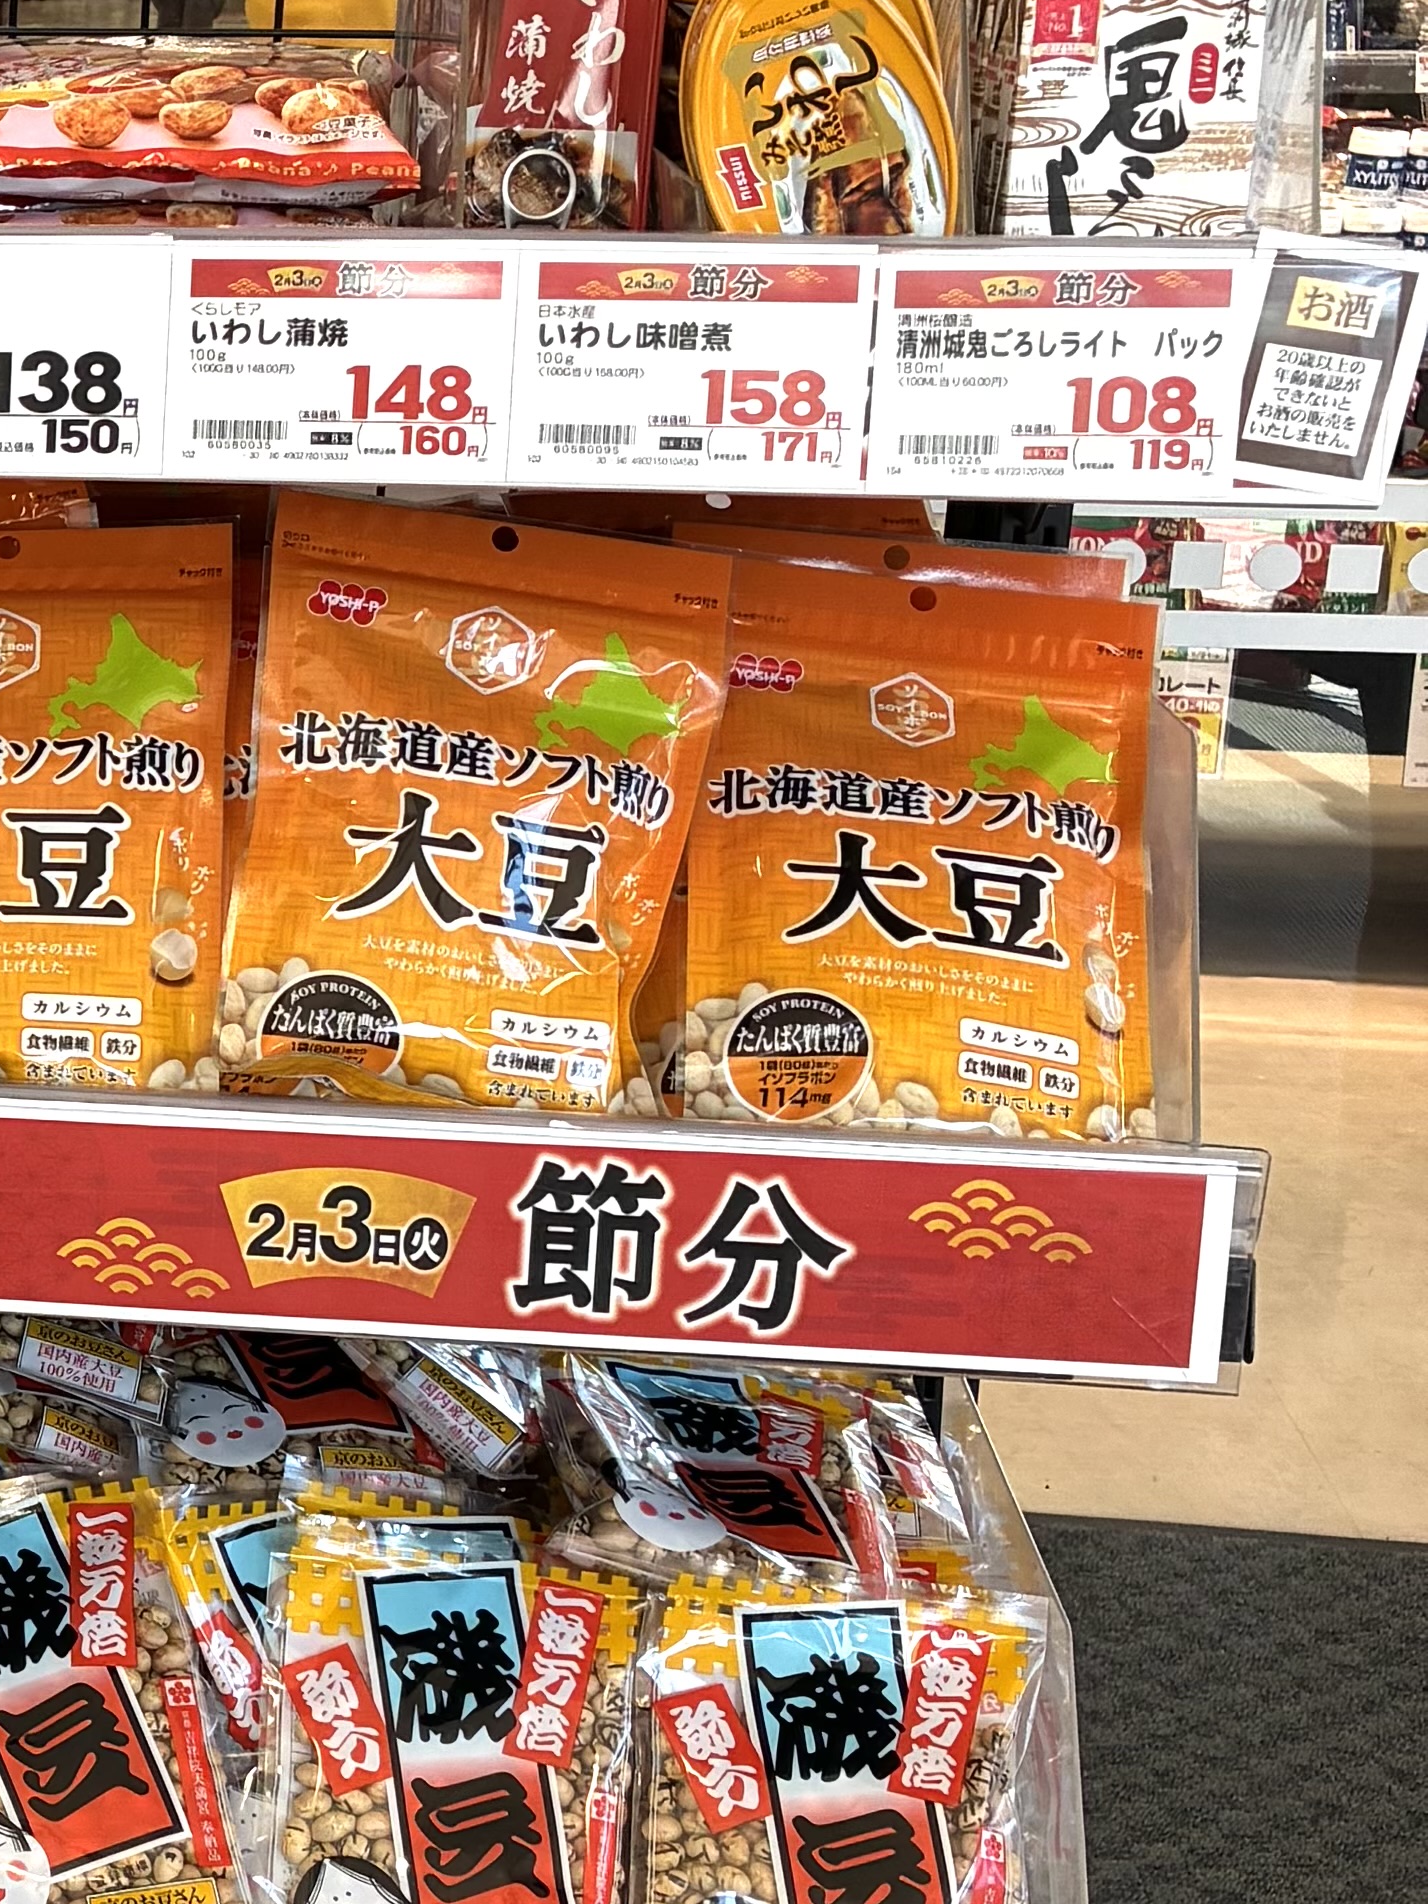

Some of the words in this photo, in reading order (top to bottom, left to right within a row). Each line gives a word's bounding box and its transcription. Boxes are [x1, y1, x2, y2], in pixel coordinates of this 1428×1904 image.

[338, 263, 414, 297] 節分
[689, 265, 773, 300] 節分
[1053, 271, 1141, 307] 節分
[191, 303, 261, 317] くらしモア
[538, 305, 595, 319] 日本水産
[1298, 286, 1378, 331] お酒
[191, 318, 349, 348] いわし蒲焼
[538, 322, 732, 351] いわし味噌煮
[1155, 329, 1224, 359] パック
[190, 349, 226, 363] 100g
[537, 352, 573, 366] 100g
[897, 361, 944, 374] 180ml
[1277, 349, 1366, 375] 20歳以上の
[1272, 386, 1352, 412] できないと
[1256, 402, 1358, 431] お酒の販売を
[1249, 421, 1352, 451] いたしません。
[280, 711, 670, 829] 北海道産ソフト煎り
[31, 996, 133, 1019] カルシウム
[735, 1018, 863, 1059] たんぱく質豊富
[756, 1070, 837, 1089] イソフラボン
[512, 1159, 849, 1333] 節分
